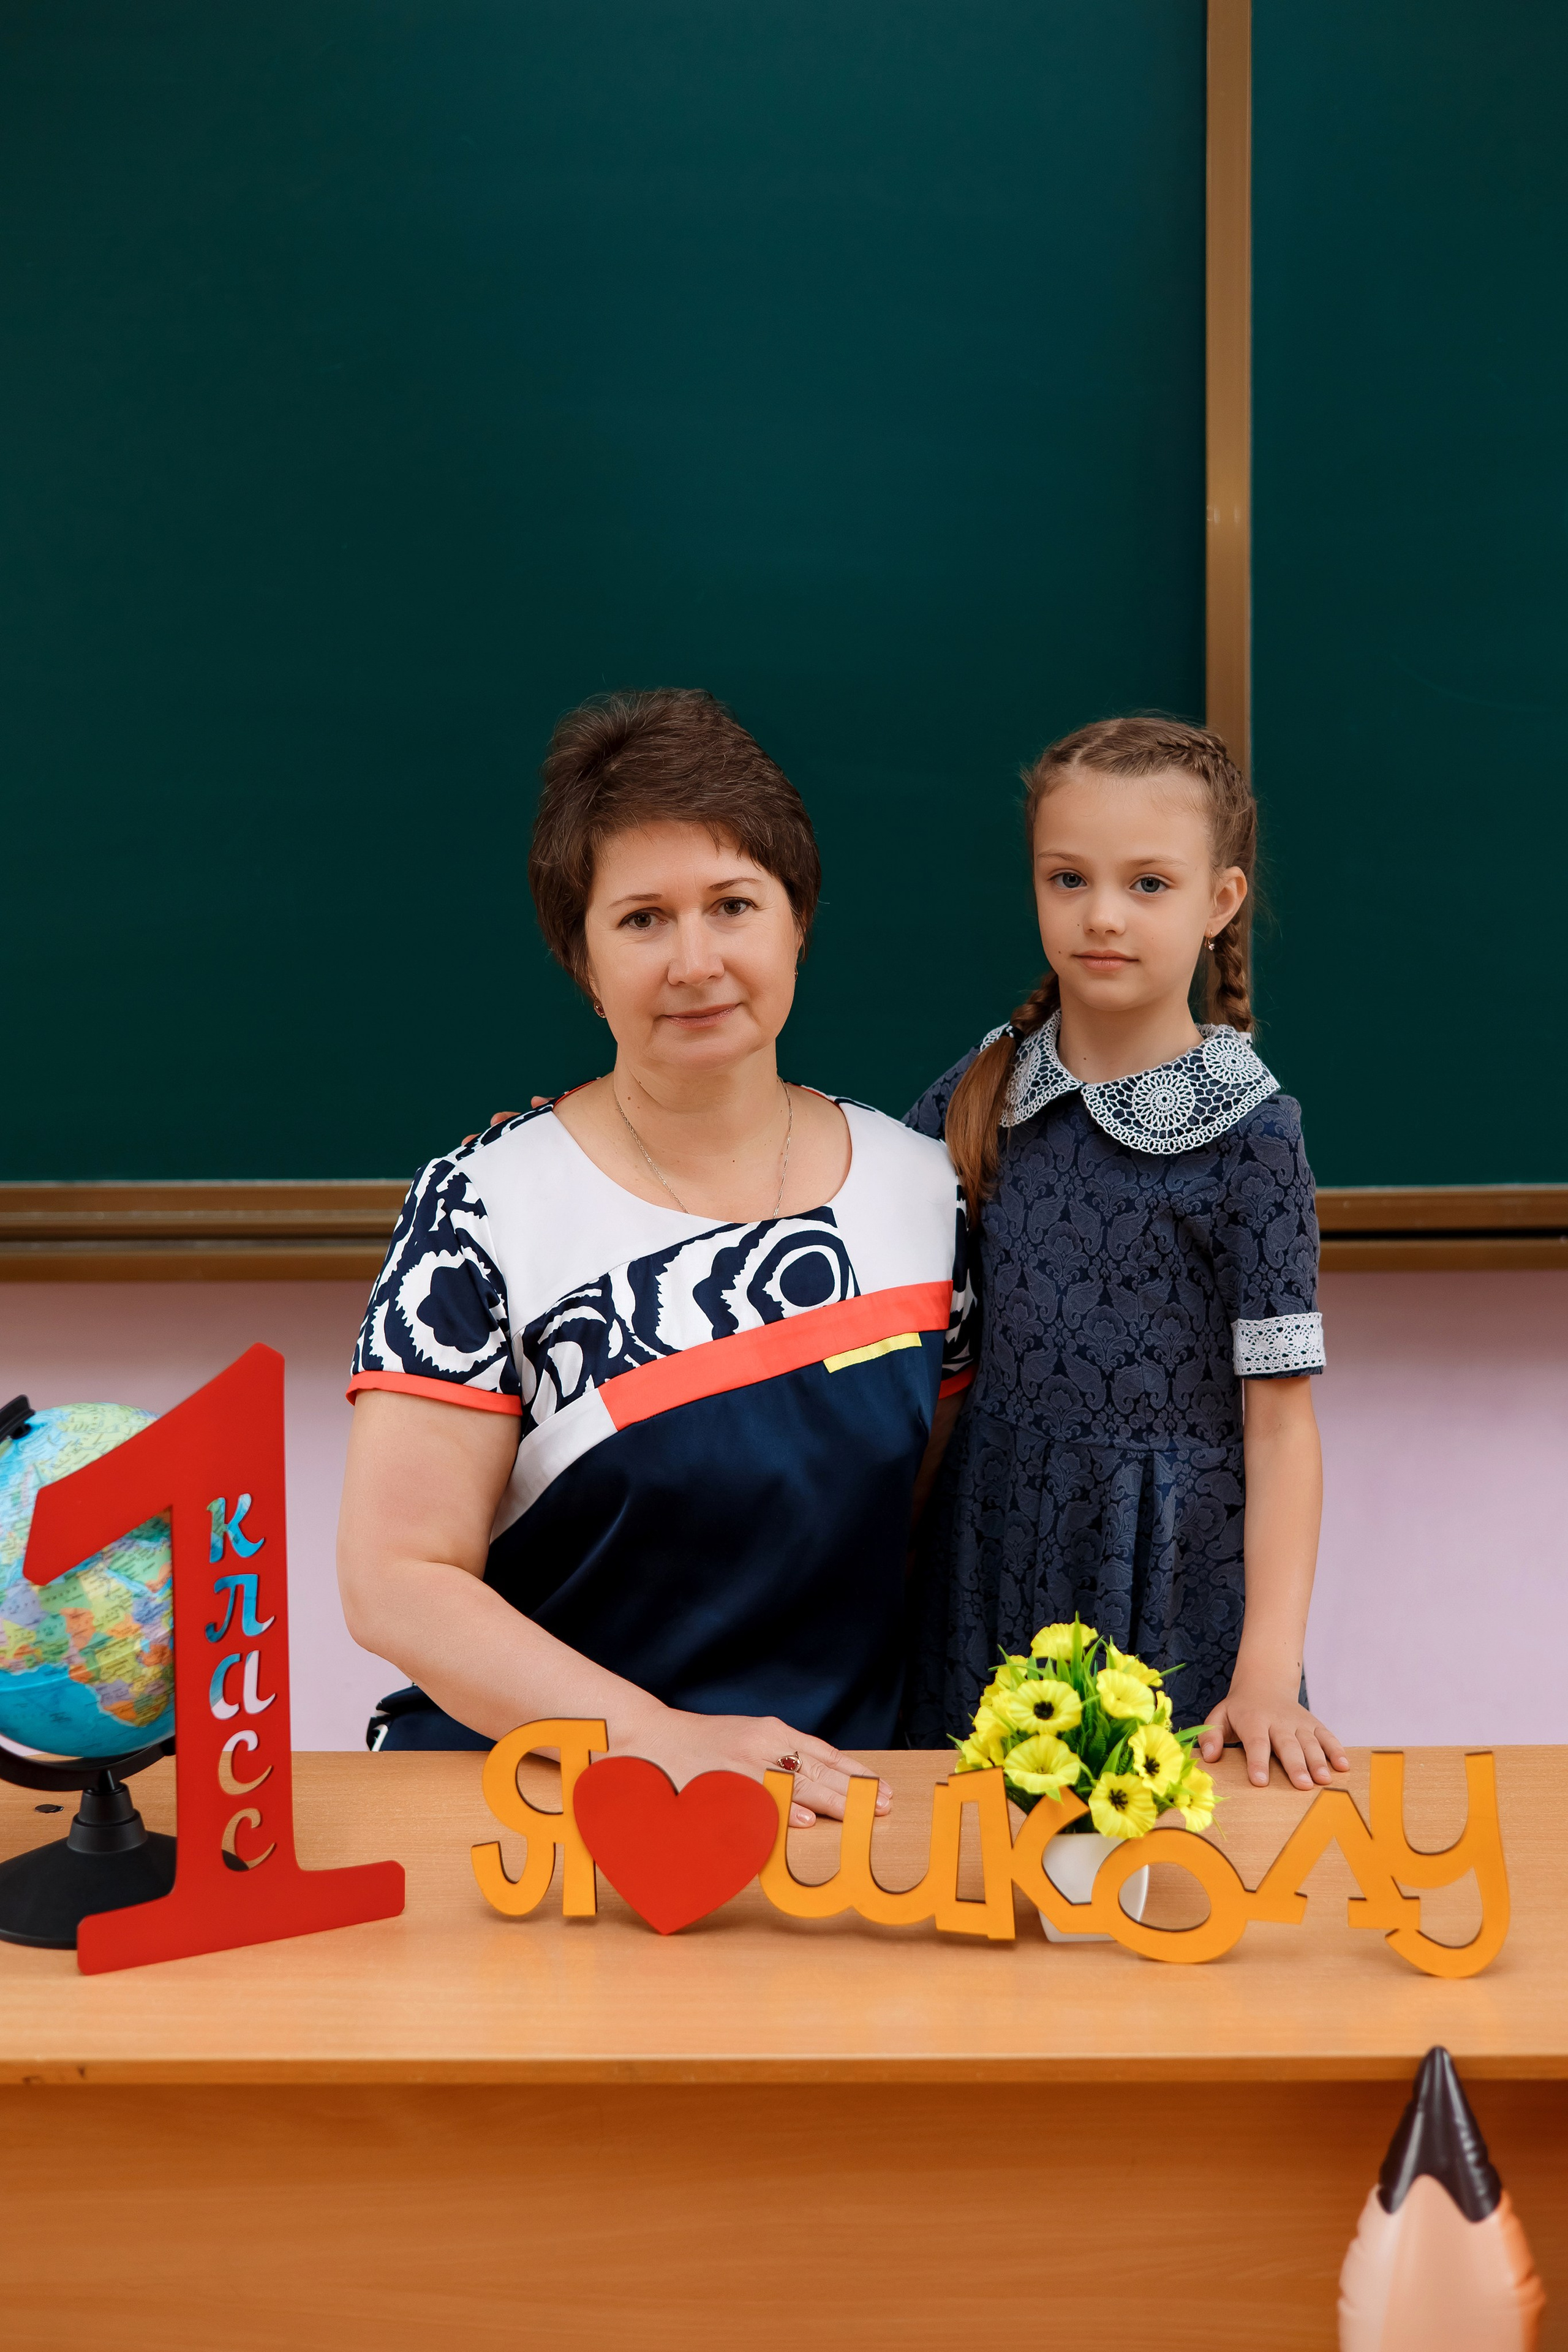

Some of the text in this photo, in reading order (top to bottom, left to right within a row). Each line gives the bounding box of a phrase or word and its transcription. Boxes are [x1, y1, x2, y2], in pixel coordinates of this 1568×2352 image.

[23, 1343, 405, 1975] 1
[205, 1493, 276, 1872] класс
[471, 1718, 609, 1917] Я
